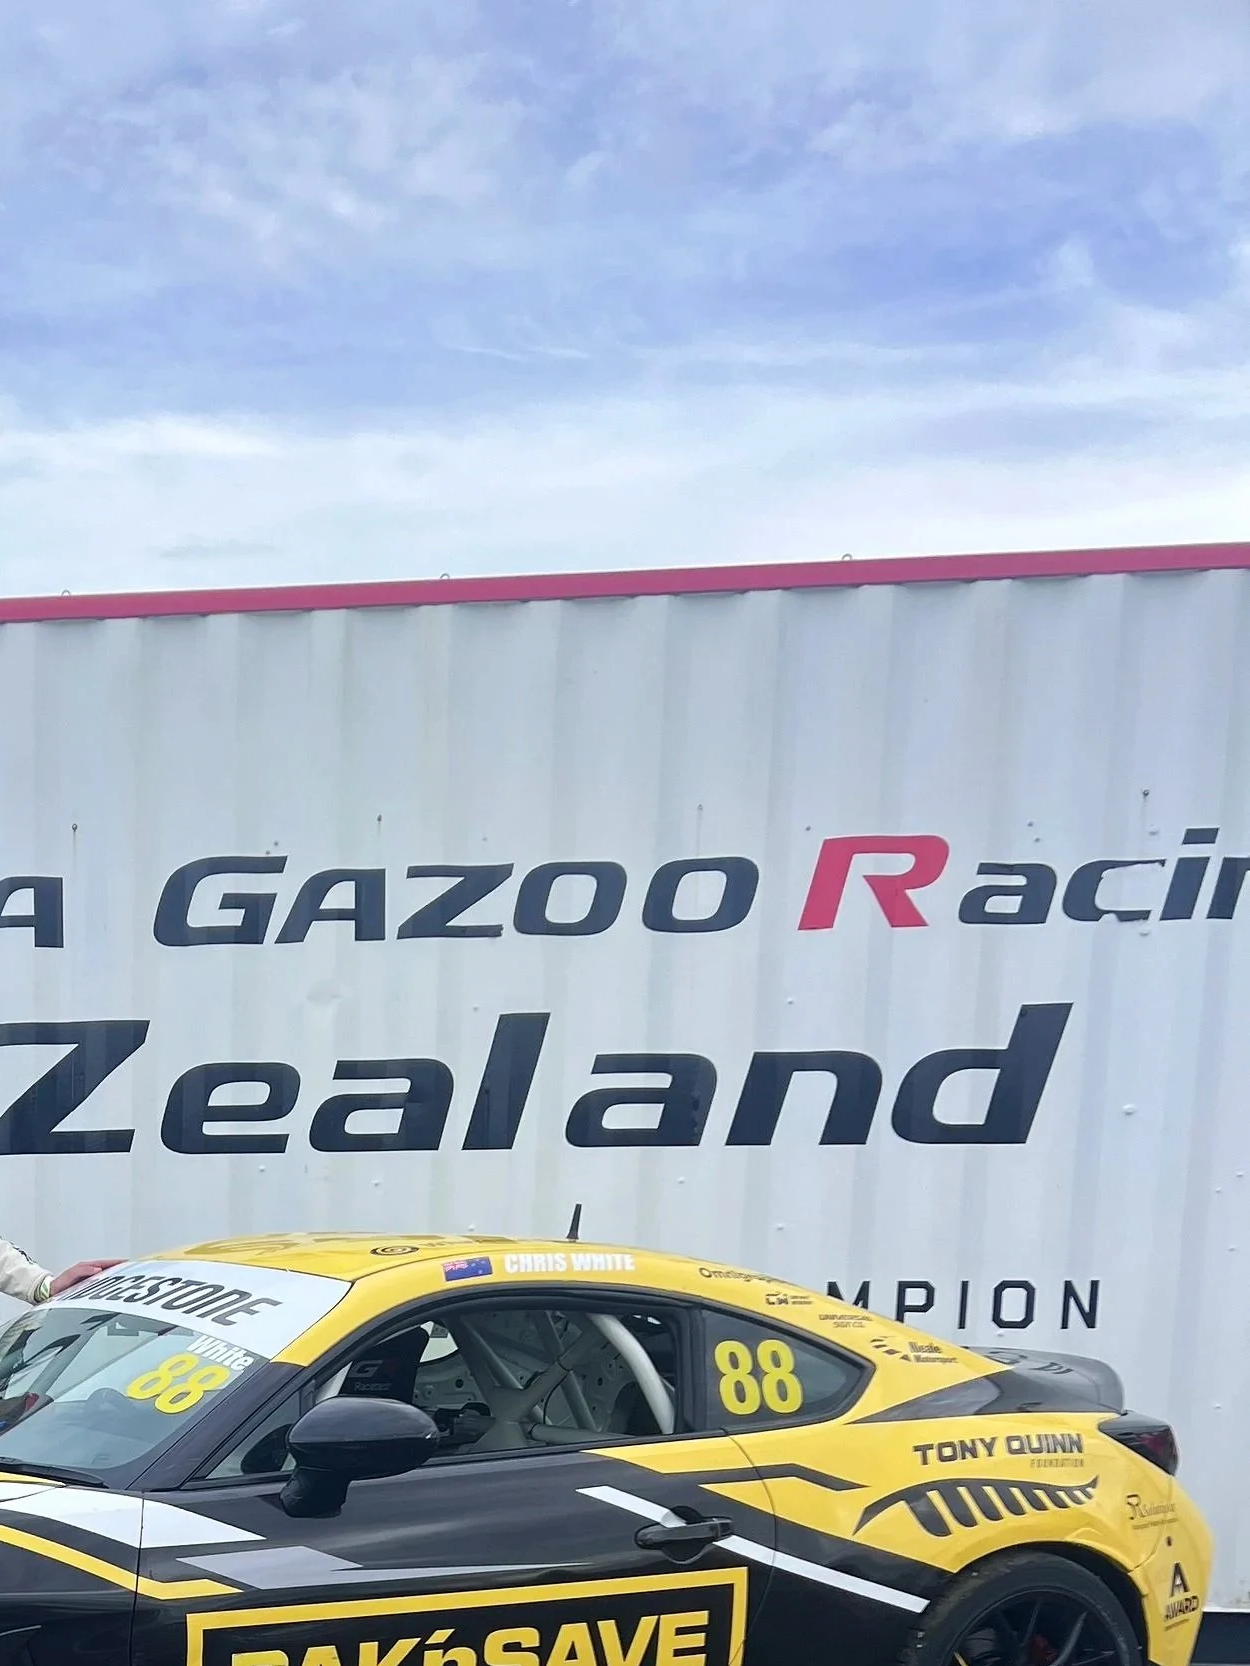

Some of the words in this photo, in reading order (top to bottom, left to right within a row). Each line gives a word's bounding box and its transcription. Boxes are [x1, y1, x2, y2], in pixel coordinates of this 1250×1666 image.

[153, 855, 759, 946] GAZOO
[504, 1253, 568, 1274] CHRIS
[571, 1252, 636, 1272] WHITE
[827, 1279, 1100, 1330] MPION
[186, 1334, 255, 1371] White
[126, 1353, 231, 1415] 88
[714, 1338, 803, 1416] 88
[912, 1436, 998, 1466] TONY
[1005, 1433, 1084, 1455] QUINN
[1165, 1595, 1200, 1621] AWARD
